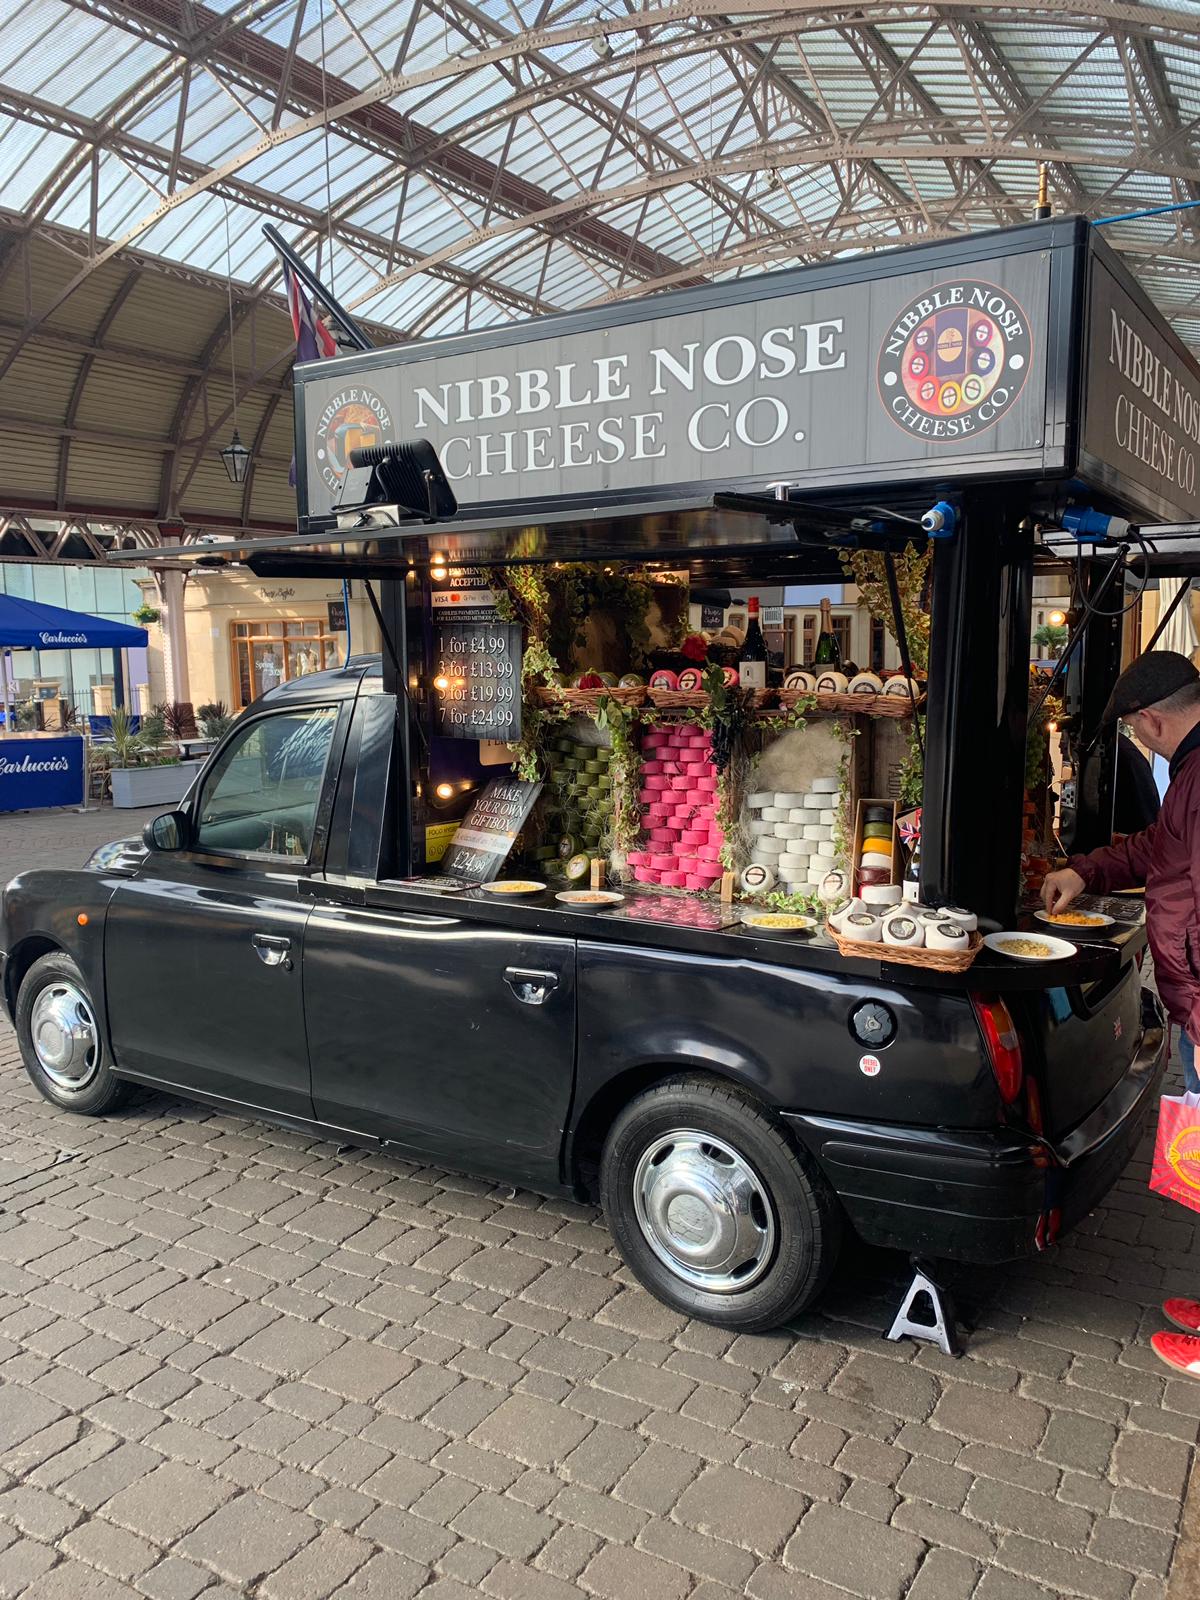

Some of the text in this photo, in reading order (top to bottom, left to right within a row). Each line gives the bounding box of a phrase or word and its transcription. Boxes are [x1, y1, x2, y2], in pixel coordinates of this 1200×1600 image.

[886, 286, 1024, 357] NIBBLE NOSE
[1108, 308, 1172, 416] NIBBLE
[413, 318, 846, 430] NIBBLE NOSE
[317, 389, 392, 438] NIBBLE NOSE
[892, 386, 1014, 437] CHEESE CO.
[440, 396, 805, 480] CHEESE CO.
[1115, 394, 1197, 497] CHEESE CO.
[449, 578, 488, 587] ACCEPTED
[434, 595, 449, 603] VISA
[39, 631, 88, 644] Carluccio's
[439, 636, 505, 654] 1 for £4.99
[438, 660, 513, 679] 3 for £13.99
[449, 684, 468, 701] for
[470, 686, 513, 703] £19.99
[439, 707, 514, 727] 7 for £24.99
[490, 787, 522, 802] MAKE
[473, 799, 527, 819] YOUR OWN
[470, 814, 514, 832] GIFTBOX
[450, 850, 486, 874] £24.99
